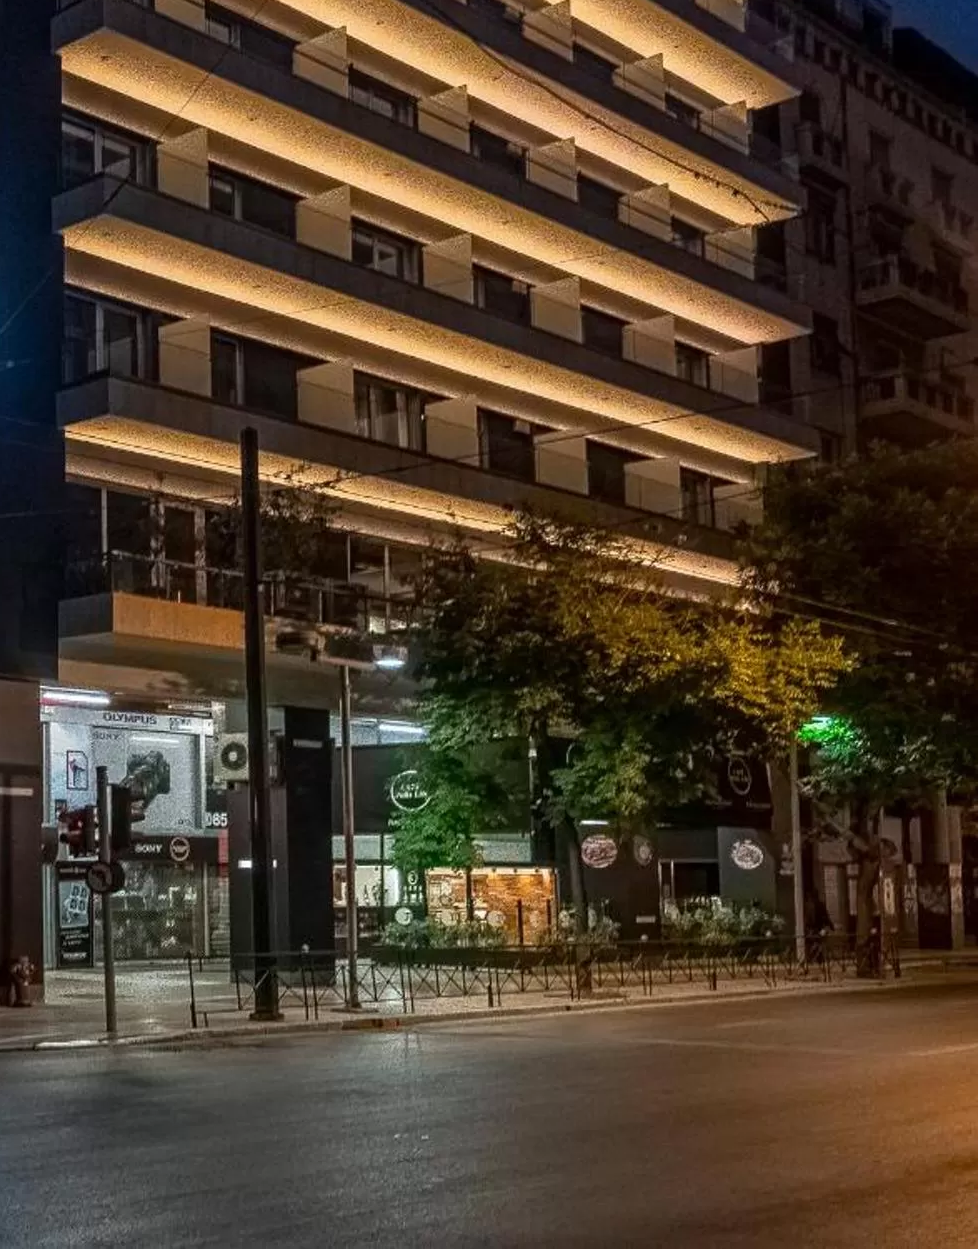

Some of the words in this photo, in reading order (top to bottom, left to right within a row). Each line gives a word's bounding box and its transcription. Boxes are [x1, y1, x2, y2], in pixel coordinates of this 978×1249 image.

[102, 712, 157, 725] OLYMPUS
[91, 731, 120, 741] SONY
[134, 844, 162, 854] SONY
